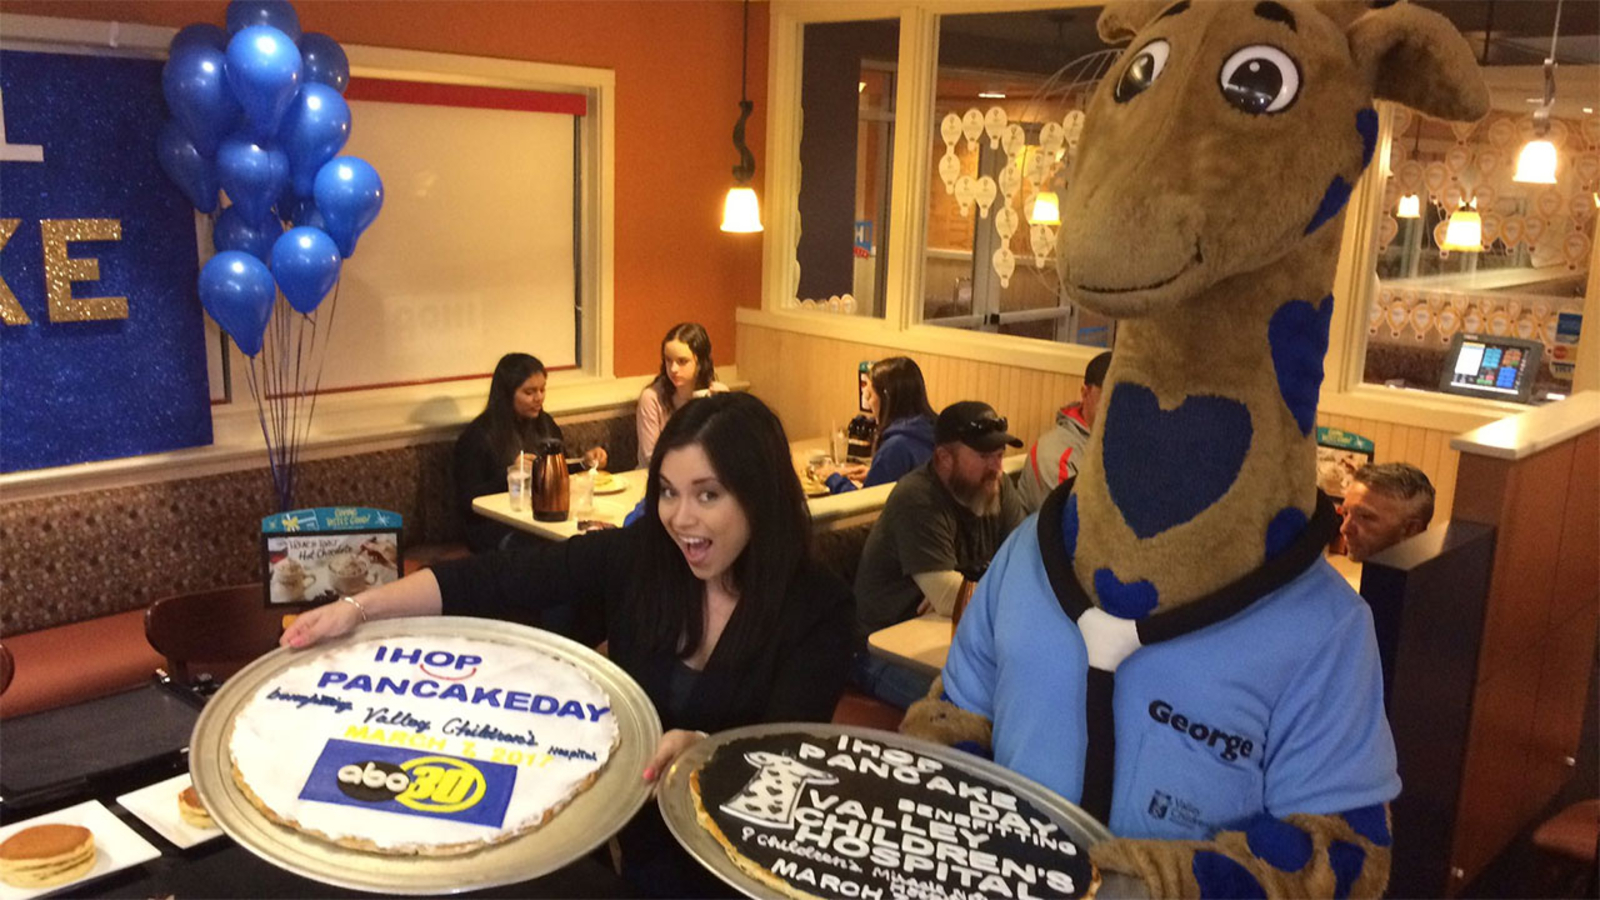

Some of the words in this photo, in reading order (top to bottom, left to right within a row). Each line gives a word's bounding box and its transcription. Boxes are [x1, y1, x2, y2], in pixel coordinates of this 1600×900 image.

[373, 645, 483, 670] IHOP
[363, 707, 431, 733] Valley
[1148, 699, 1254, 762] George
[344, 724, 447, 752] MARCH
[490, 746, 555, 768] 2017
[837, 734, 943, 773] IHOP
[799, 742, 1017, 812] PANCAKE
[810, 789, 990, 849] VALLEY
[897, 798, 1077, 856] BENEFITTING
[969, 800, 1058, 837] DAY
[795, 807, 1075, 894] CHILDREN'S
[795, 825, 1043, 900] HOSPITAL
[771, 858, 883, 900] MARCH
